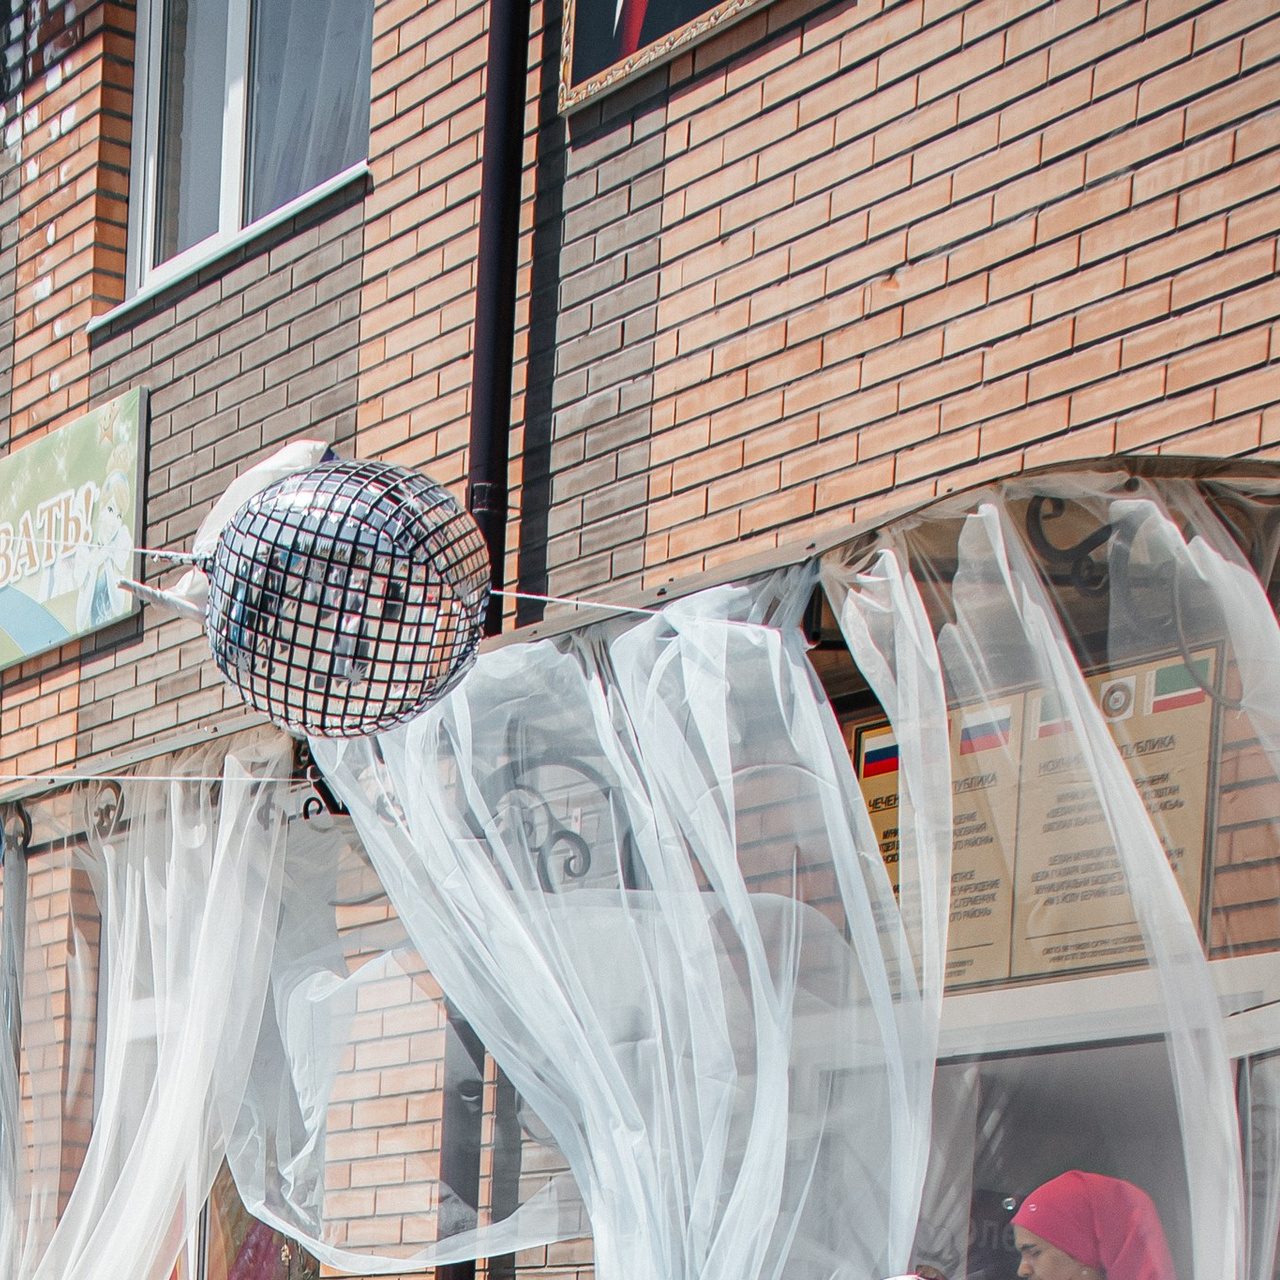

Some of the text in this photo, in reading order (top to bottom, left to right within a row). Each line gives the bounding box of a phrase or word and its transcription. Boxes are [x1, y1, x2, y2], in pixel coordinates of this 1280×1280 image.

[1120, 735, 1176, 757] ПУБЛИКА
[868, 772, 997, 811] ЧЕЧЕН ПУБЛИКА
